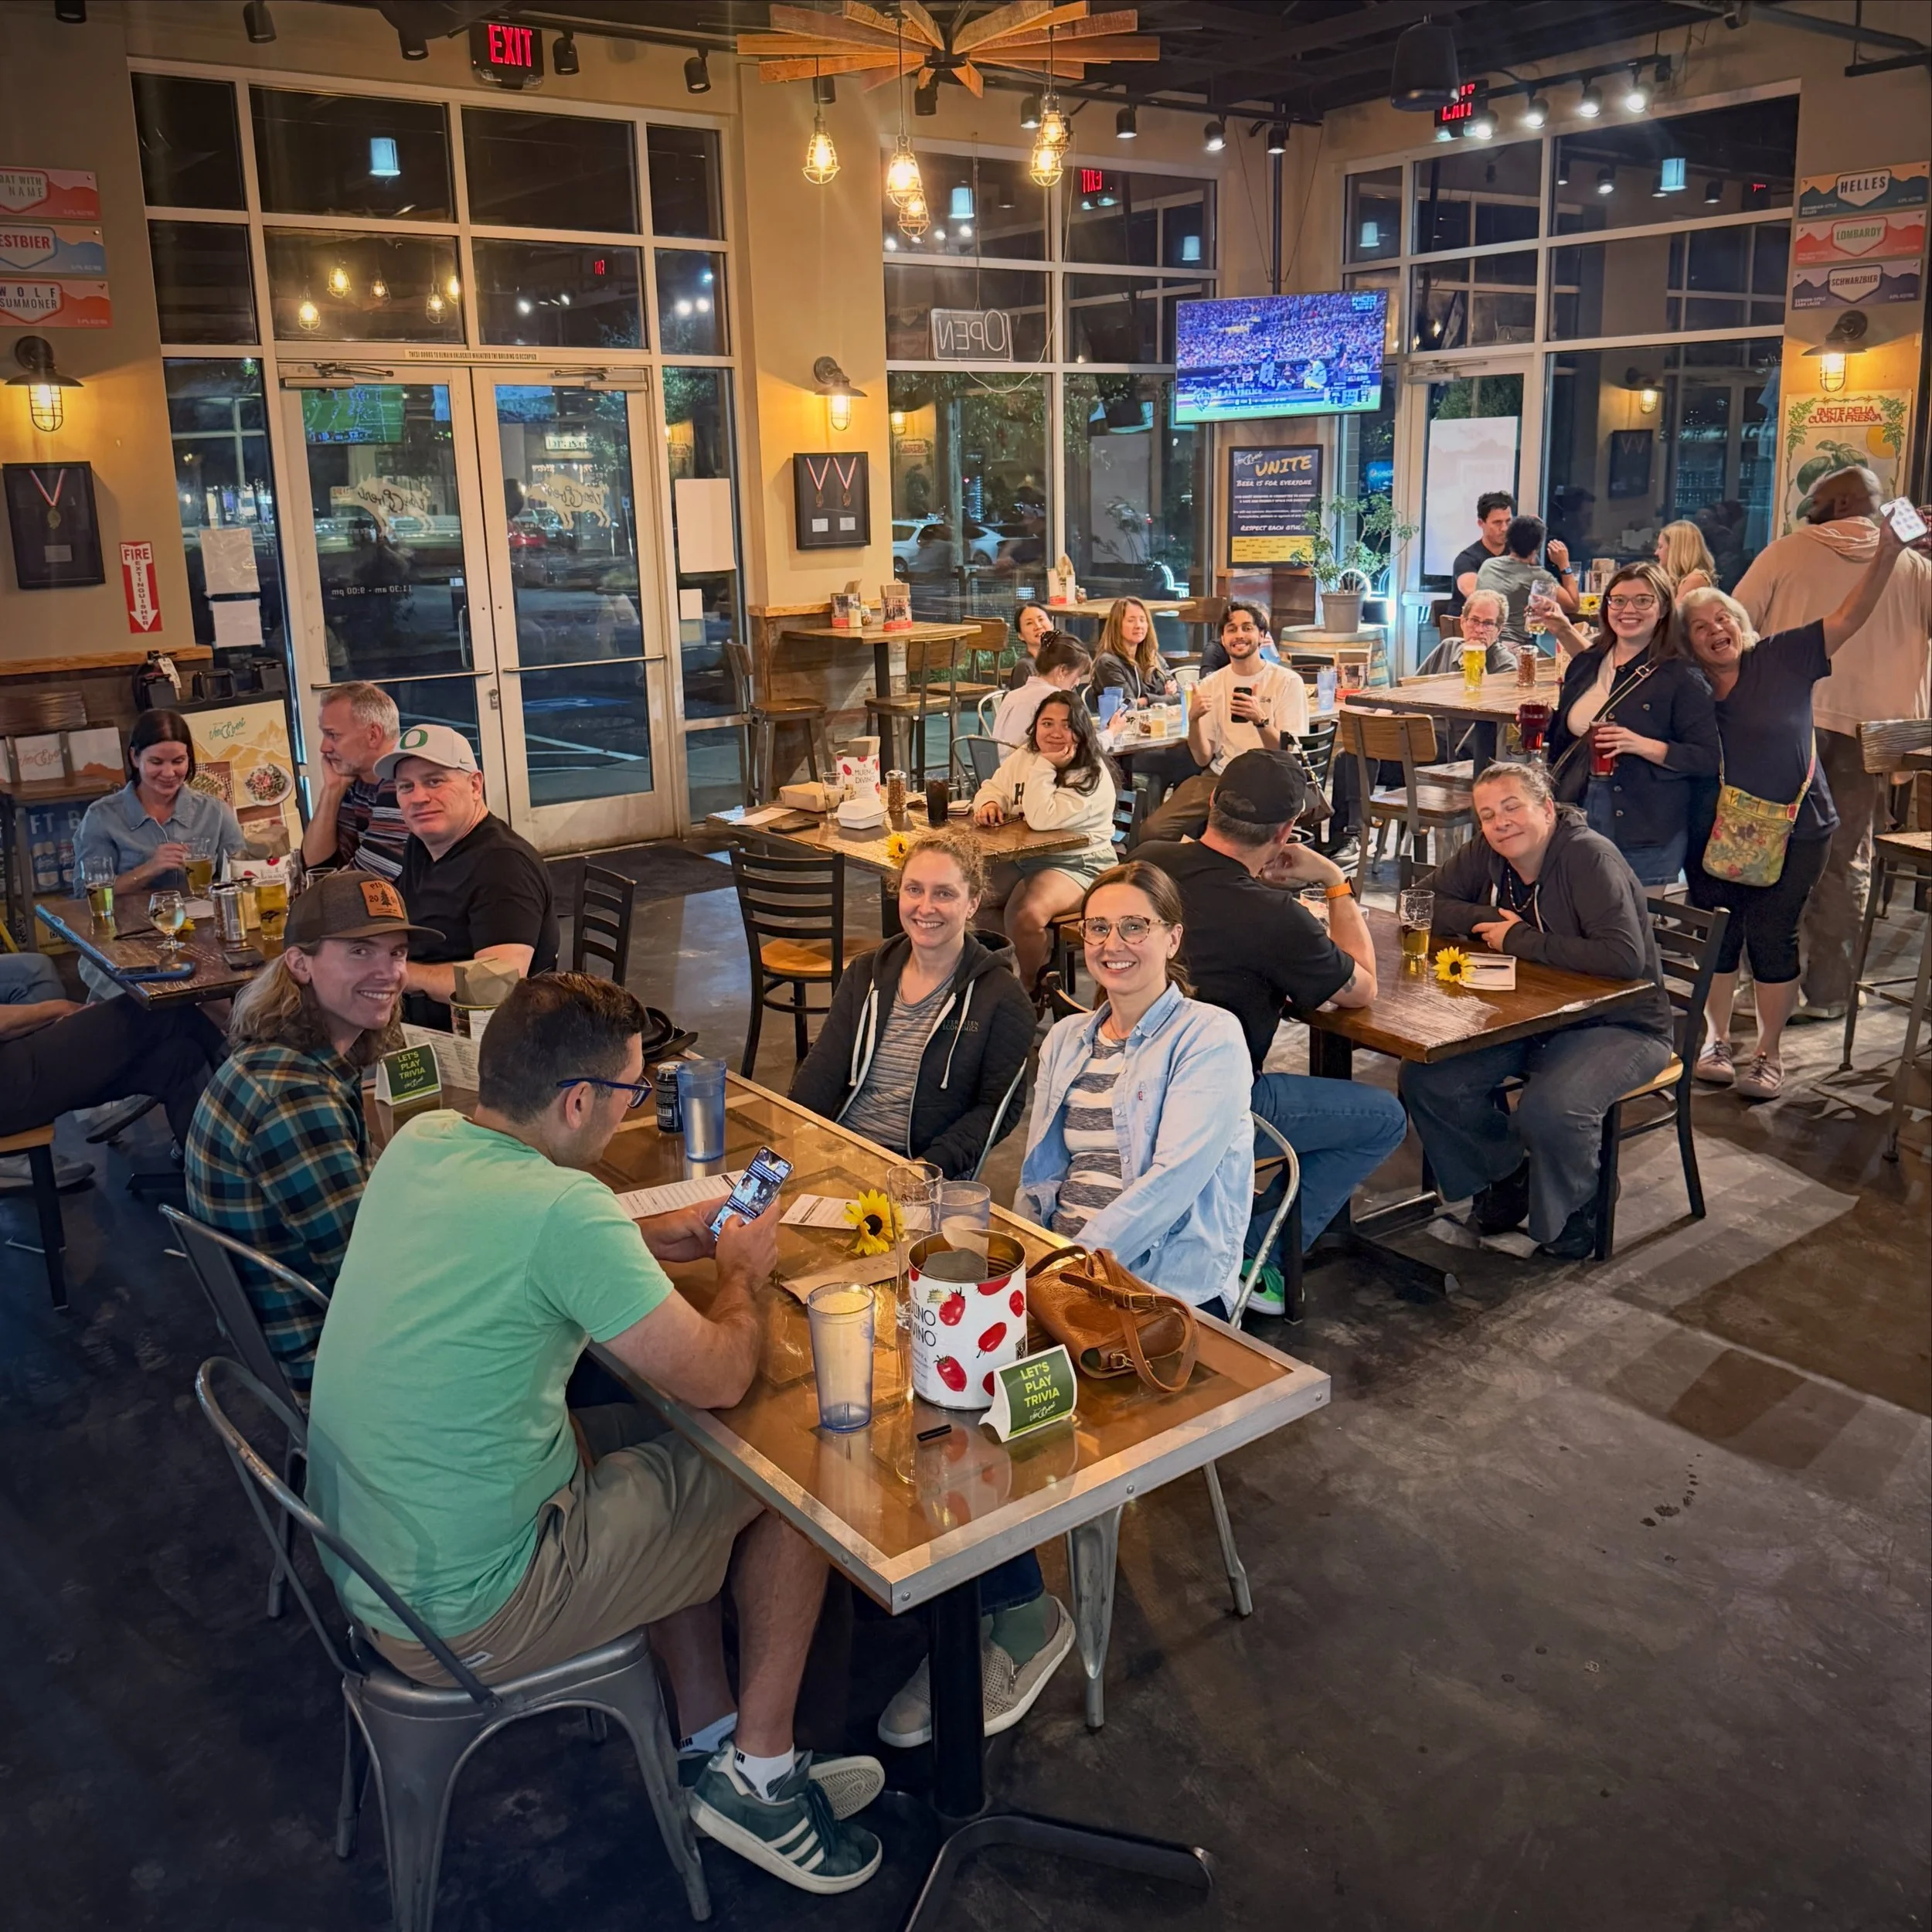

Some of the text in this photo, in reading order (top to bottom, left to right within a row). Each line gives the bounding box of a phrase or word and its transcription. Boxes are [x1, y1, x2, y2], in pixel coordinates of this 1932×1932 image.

[488, 24, 532, 67] EXIT
[19, 175, 42, 185] WITH
[1840, 176, 1886, 193] HELLES
[9, 185, 43, 198] NAME
[1836, 226, 1882, 240] LOMBARDY
[1832, 274, 1878, 287] SCHWARZBIER
[0, 298, 56, 309] SUMMONER
[1817, 406, 1875, 416] L'ARTE DELLA
[1808, 413, 1883, 423] CUCINA FRESCA
[1255, 454, 1312, 476] UNITE
[124, 548, 150, 561] FIRE
[134, 560, 149, 625] EXTINGUISHER
[400, 729, 428, 750] O
[34, 748, 60, 766] Ebe
[397, 1051, 419, 1063] LET'S
[400, 1059, 420, 1070] PLAY
[399, 1067, 426, 1079] TRIVIA
[1020, 1361, 1050, 1380] LET'S
[1025, 1374, 1051, 1393] PLAY
[1024, 1387, 1060, 1407] TRIVIA
